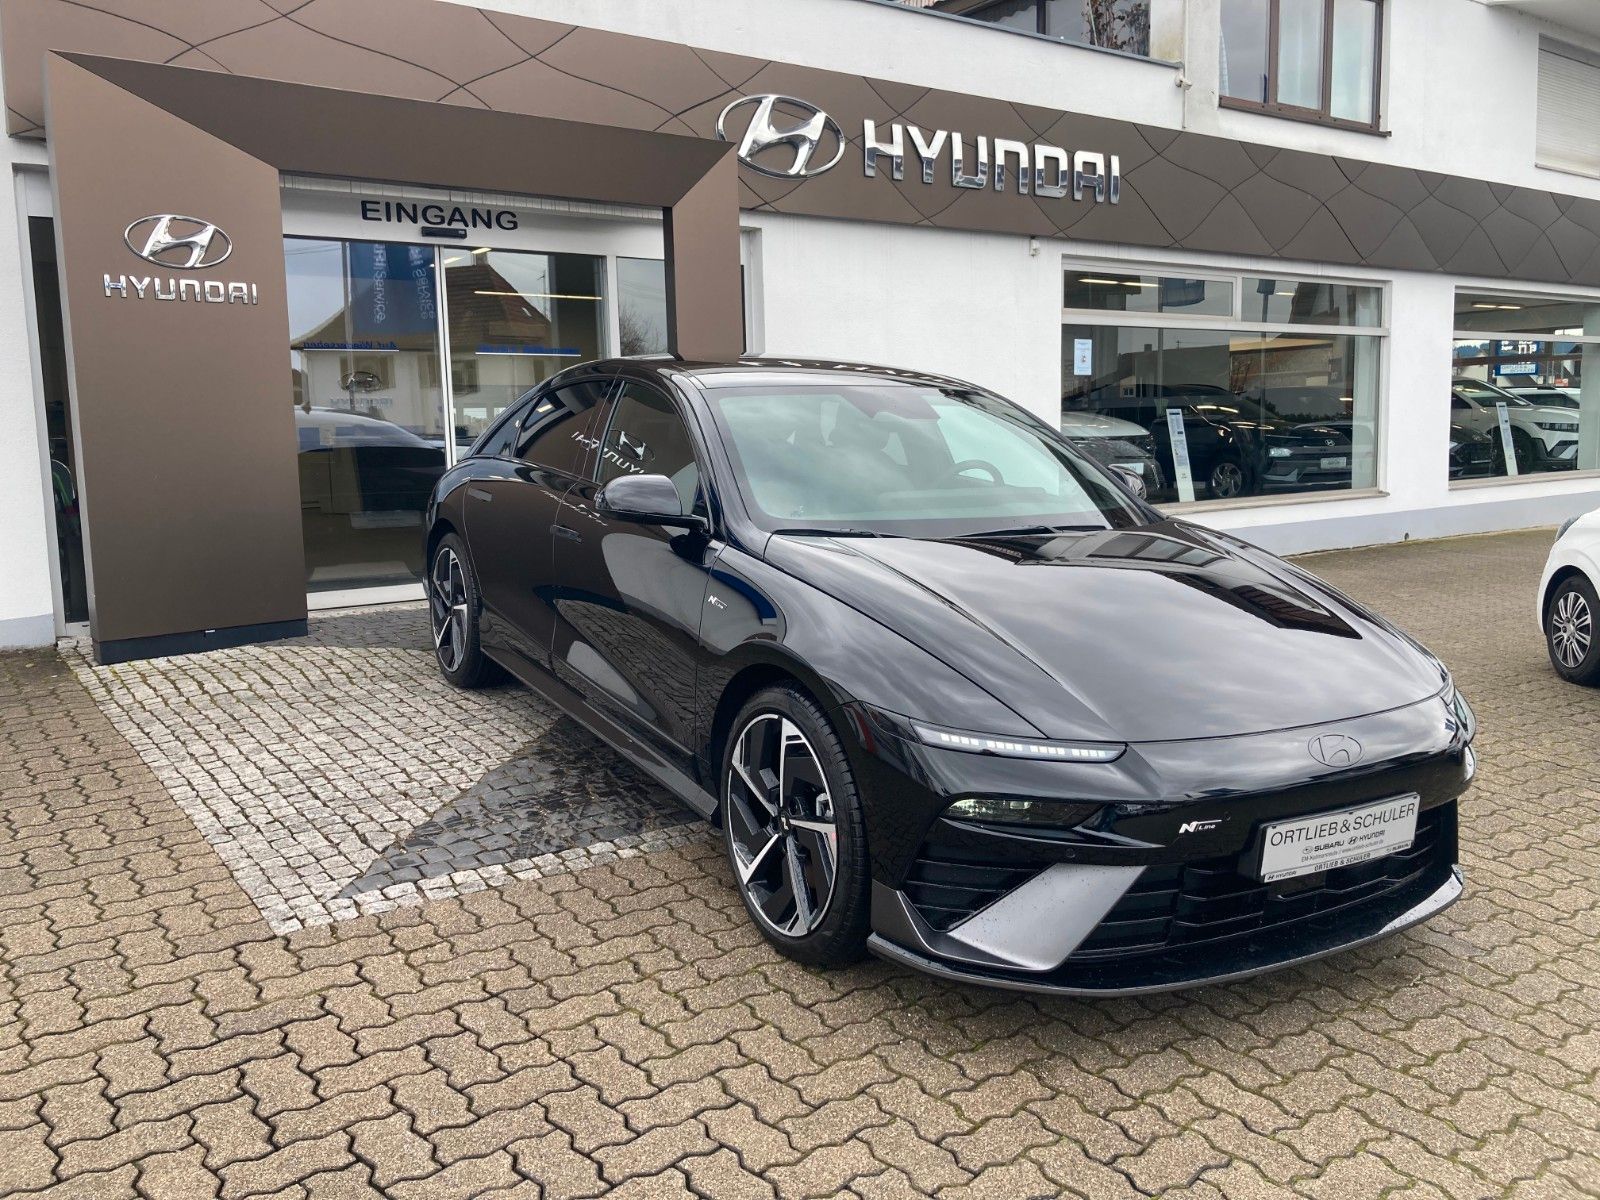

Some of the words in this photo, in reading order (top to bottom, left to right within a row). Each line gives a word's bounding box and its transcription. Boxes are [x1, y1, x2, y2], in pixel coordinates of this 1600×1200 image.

[864, 119, 1121, 205] HYUNDAI
[361, 200, 519, 231] EINGANG
[103, 273, 259, 305] HYUNDAI
[1314, 840, 1345, 852] SUBARU
[1358, 829, 1386, 841] HYUNDAI
[1314, 860, 1339, 872] ORTLIEB
[1345, 852, 1371, 864] SCHULER
